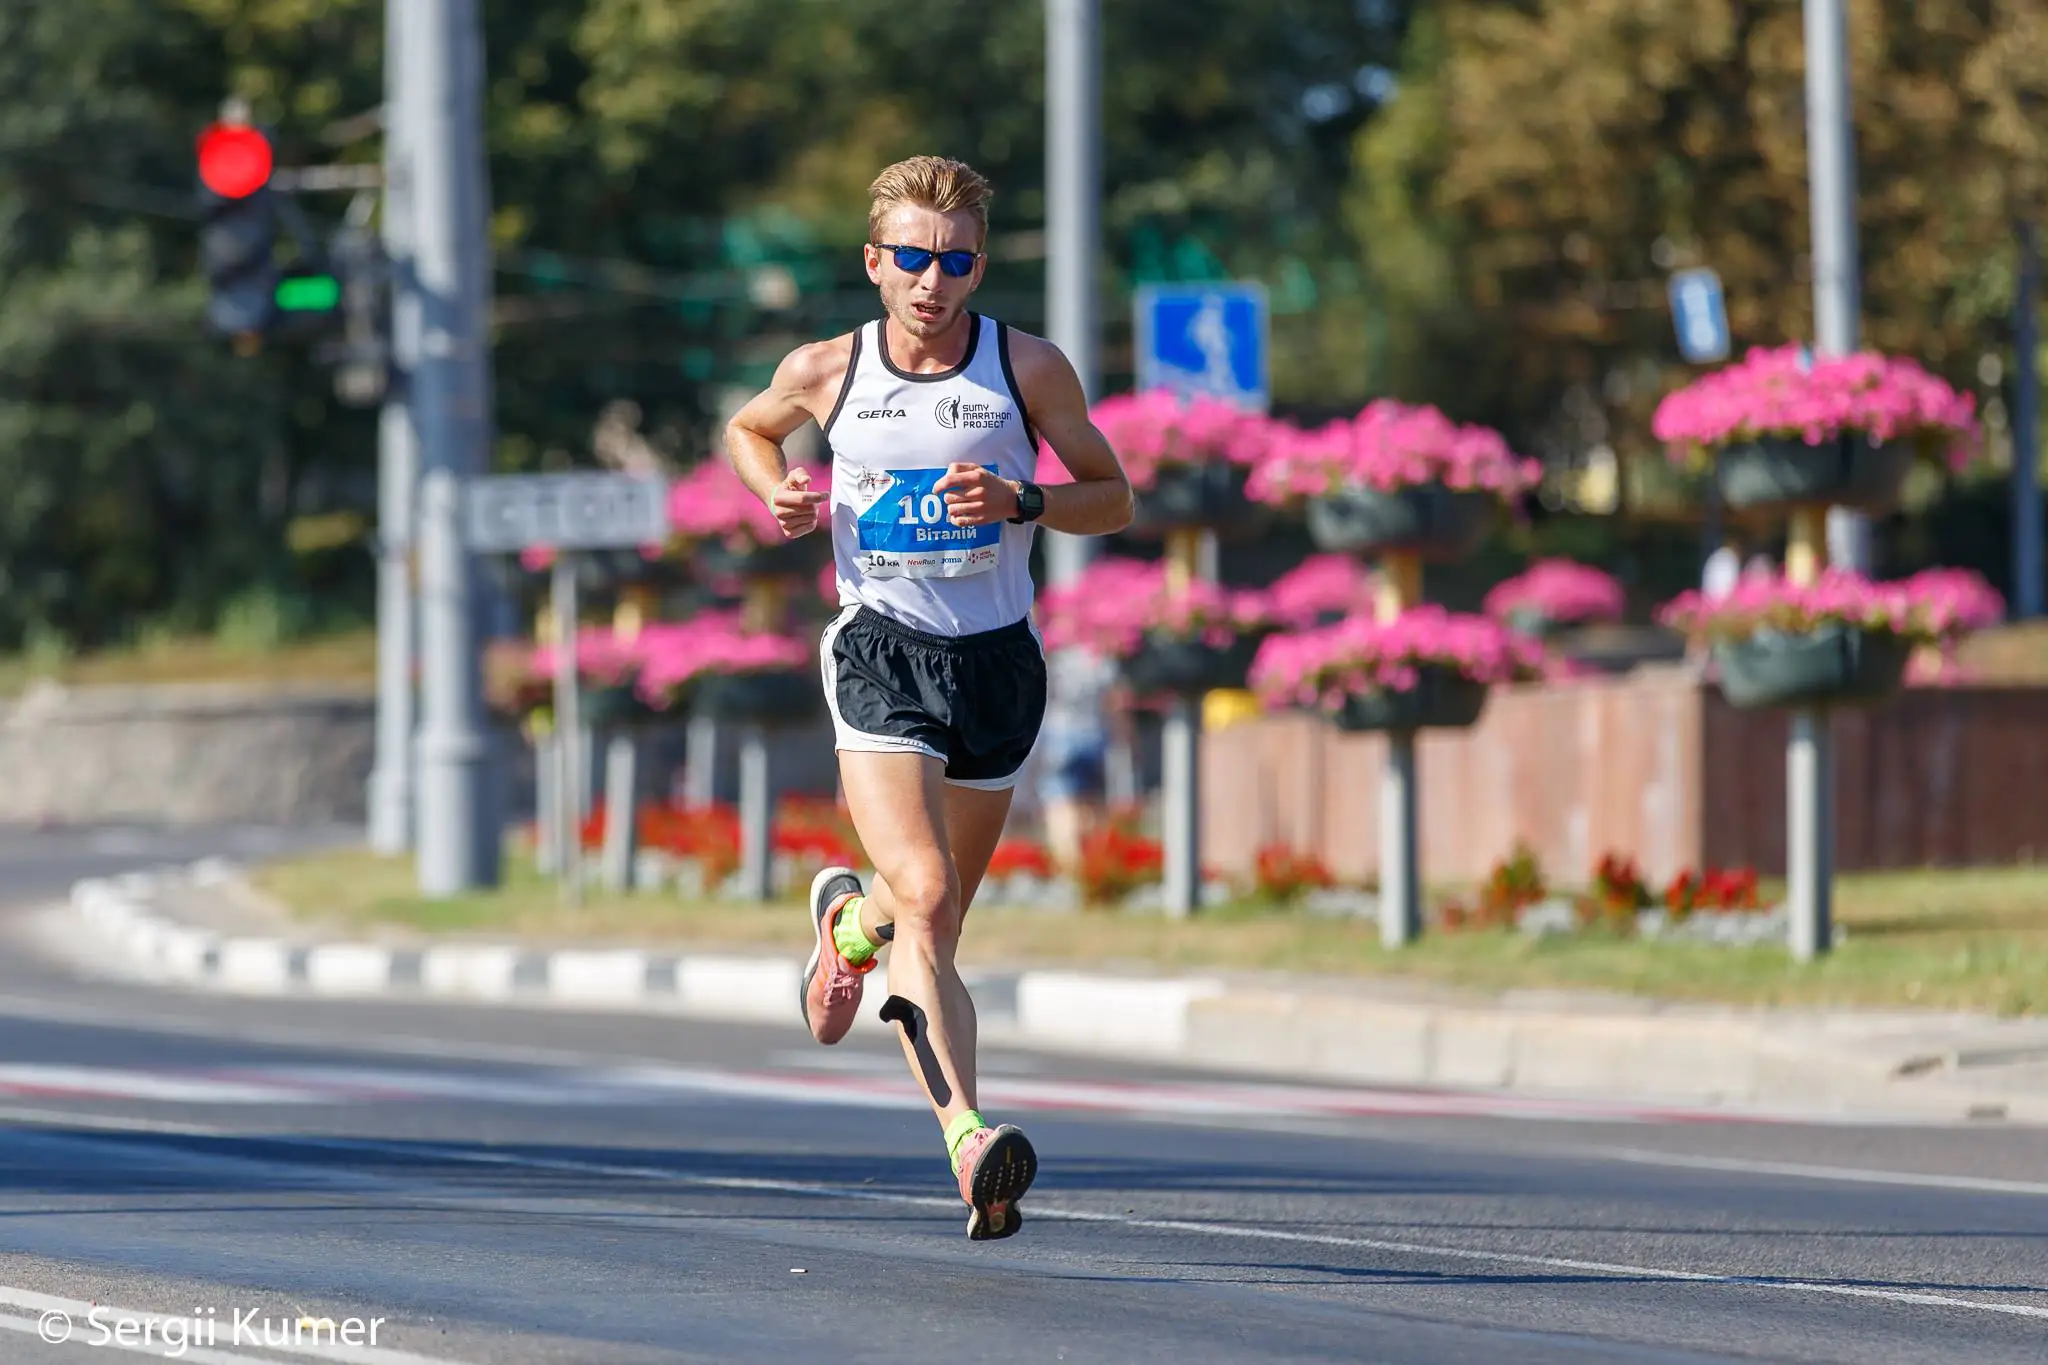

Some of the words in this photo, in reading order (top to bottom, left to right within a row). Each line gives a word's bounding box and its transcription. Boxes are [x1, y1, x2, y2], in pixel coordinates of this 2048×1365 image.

[962, 404, 989, 412] SUMY
[857, 409, 907, 419] GERA
[962, 412, 1012, 420] MARATHON
[963, 420, 1005, 428] PROJECT
[916, 526, 977, 541] Віталій
[868, 554, 885, 566] 10
